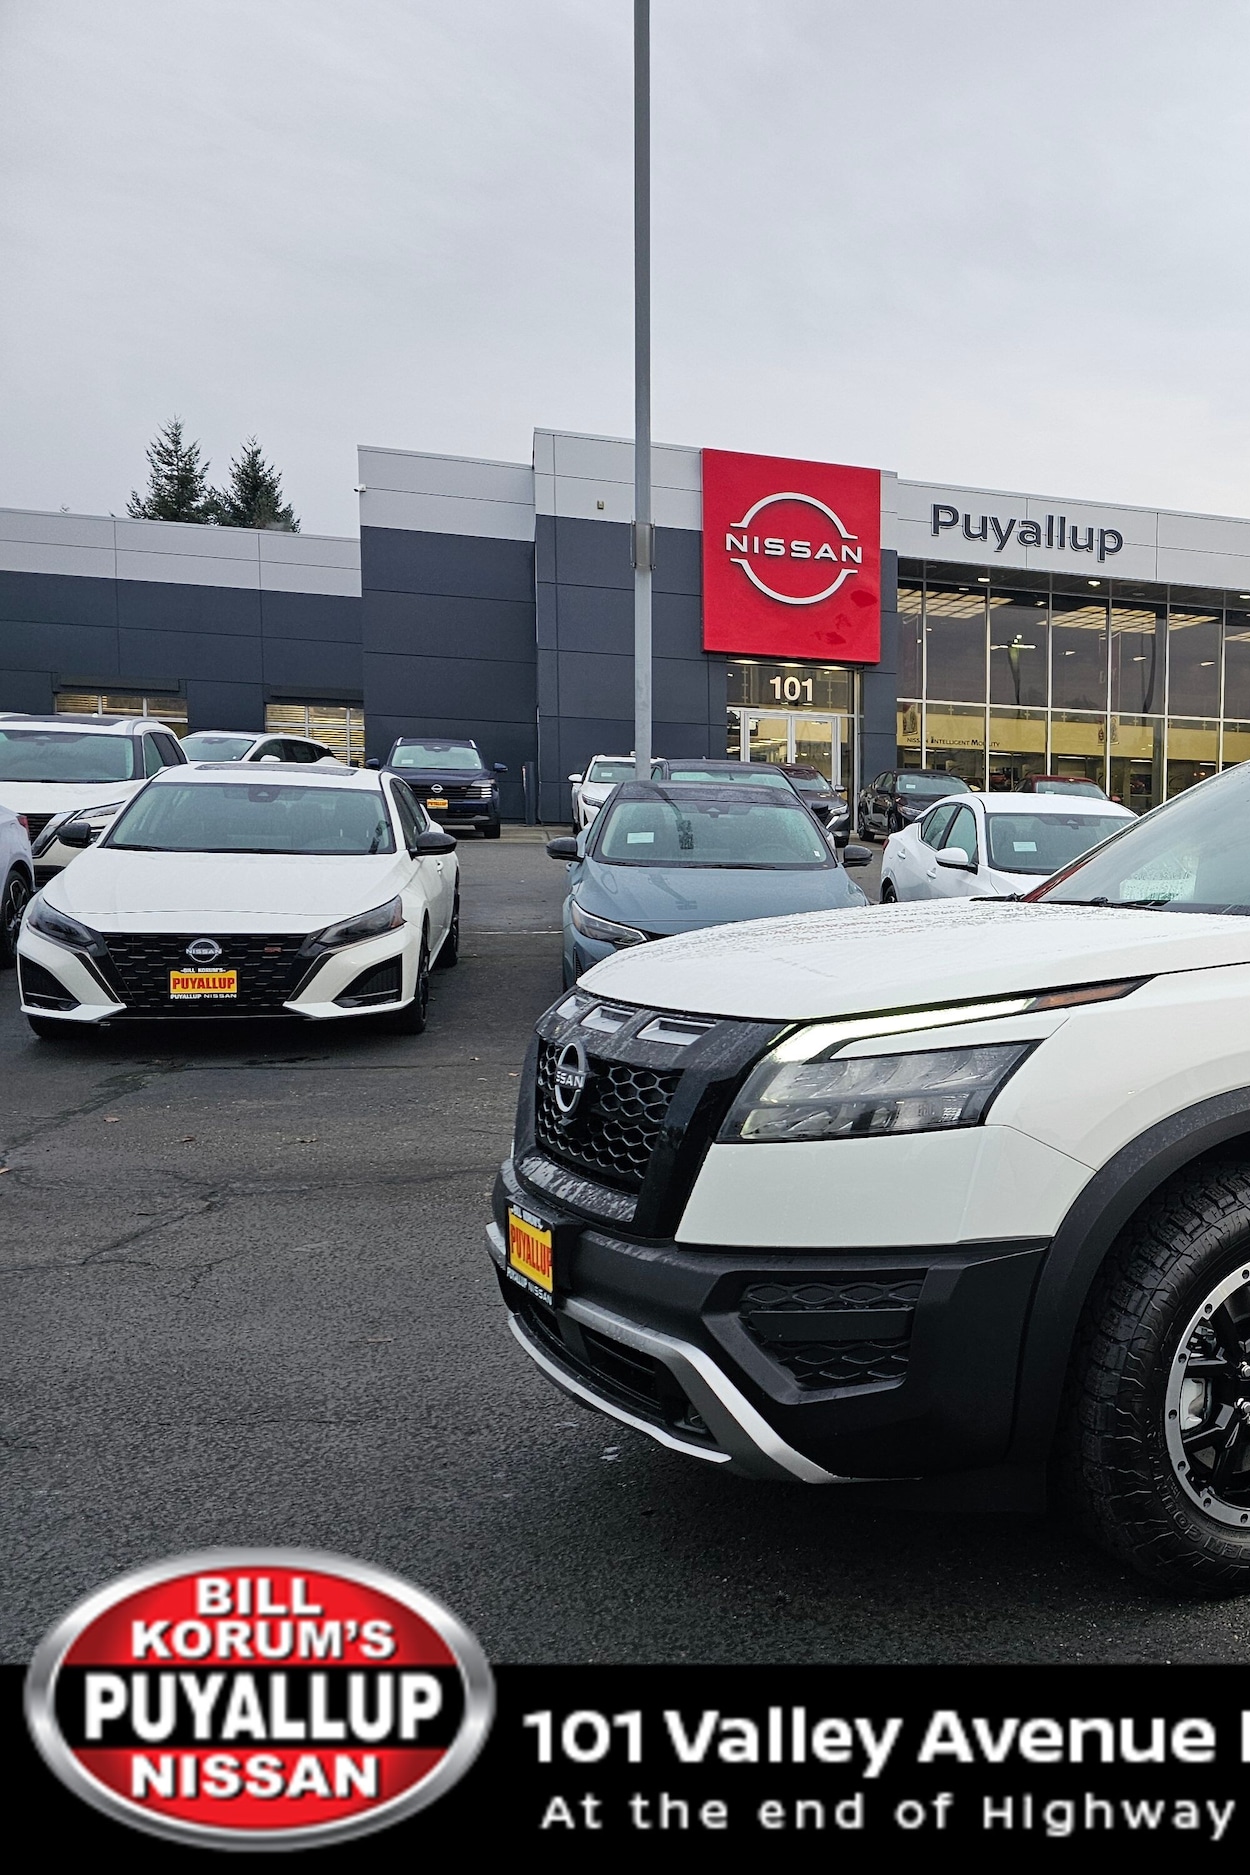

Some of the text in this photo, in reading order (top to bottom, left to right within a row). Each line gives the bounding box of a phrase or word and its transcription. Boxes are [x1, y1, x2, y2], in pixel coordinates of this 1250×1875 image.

[931, 503, 1123, 563] Puyallup
[726, 533, 862, 564] NISSAN
[769, 676, 813, 702] 101
[172, 978, 235, 990] PUYALLUP
[555, 1070, 584, 1088] SSAN
[510, 1223, 552, 1278] PUYALLUP
